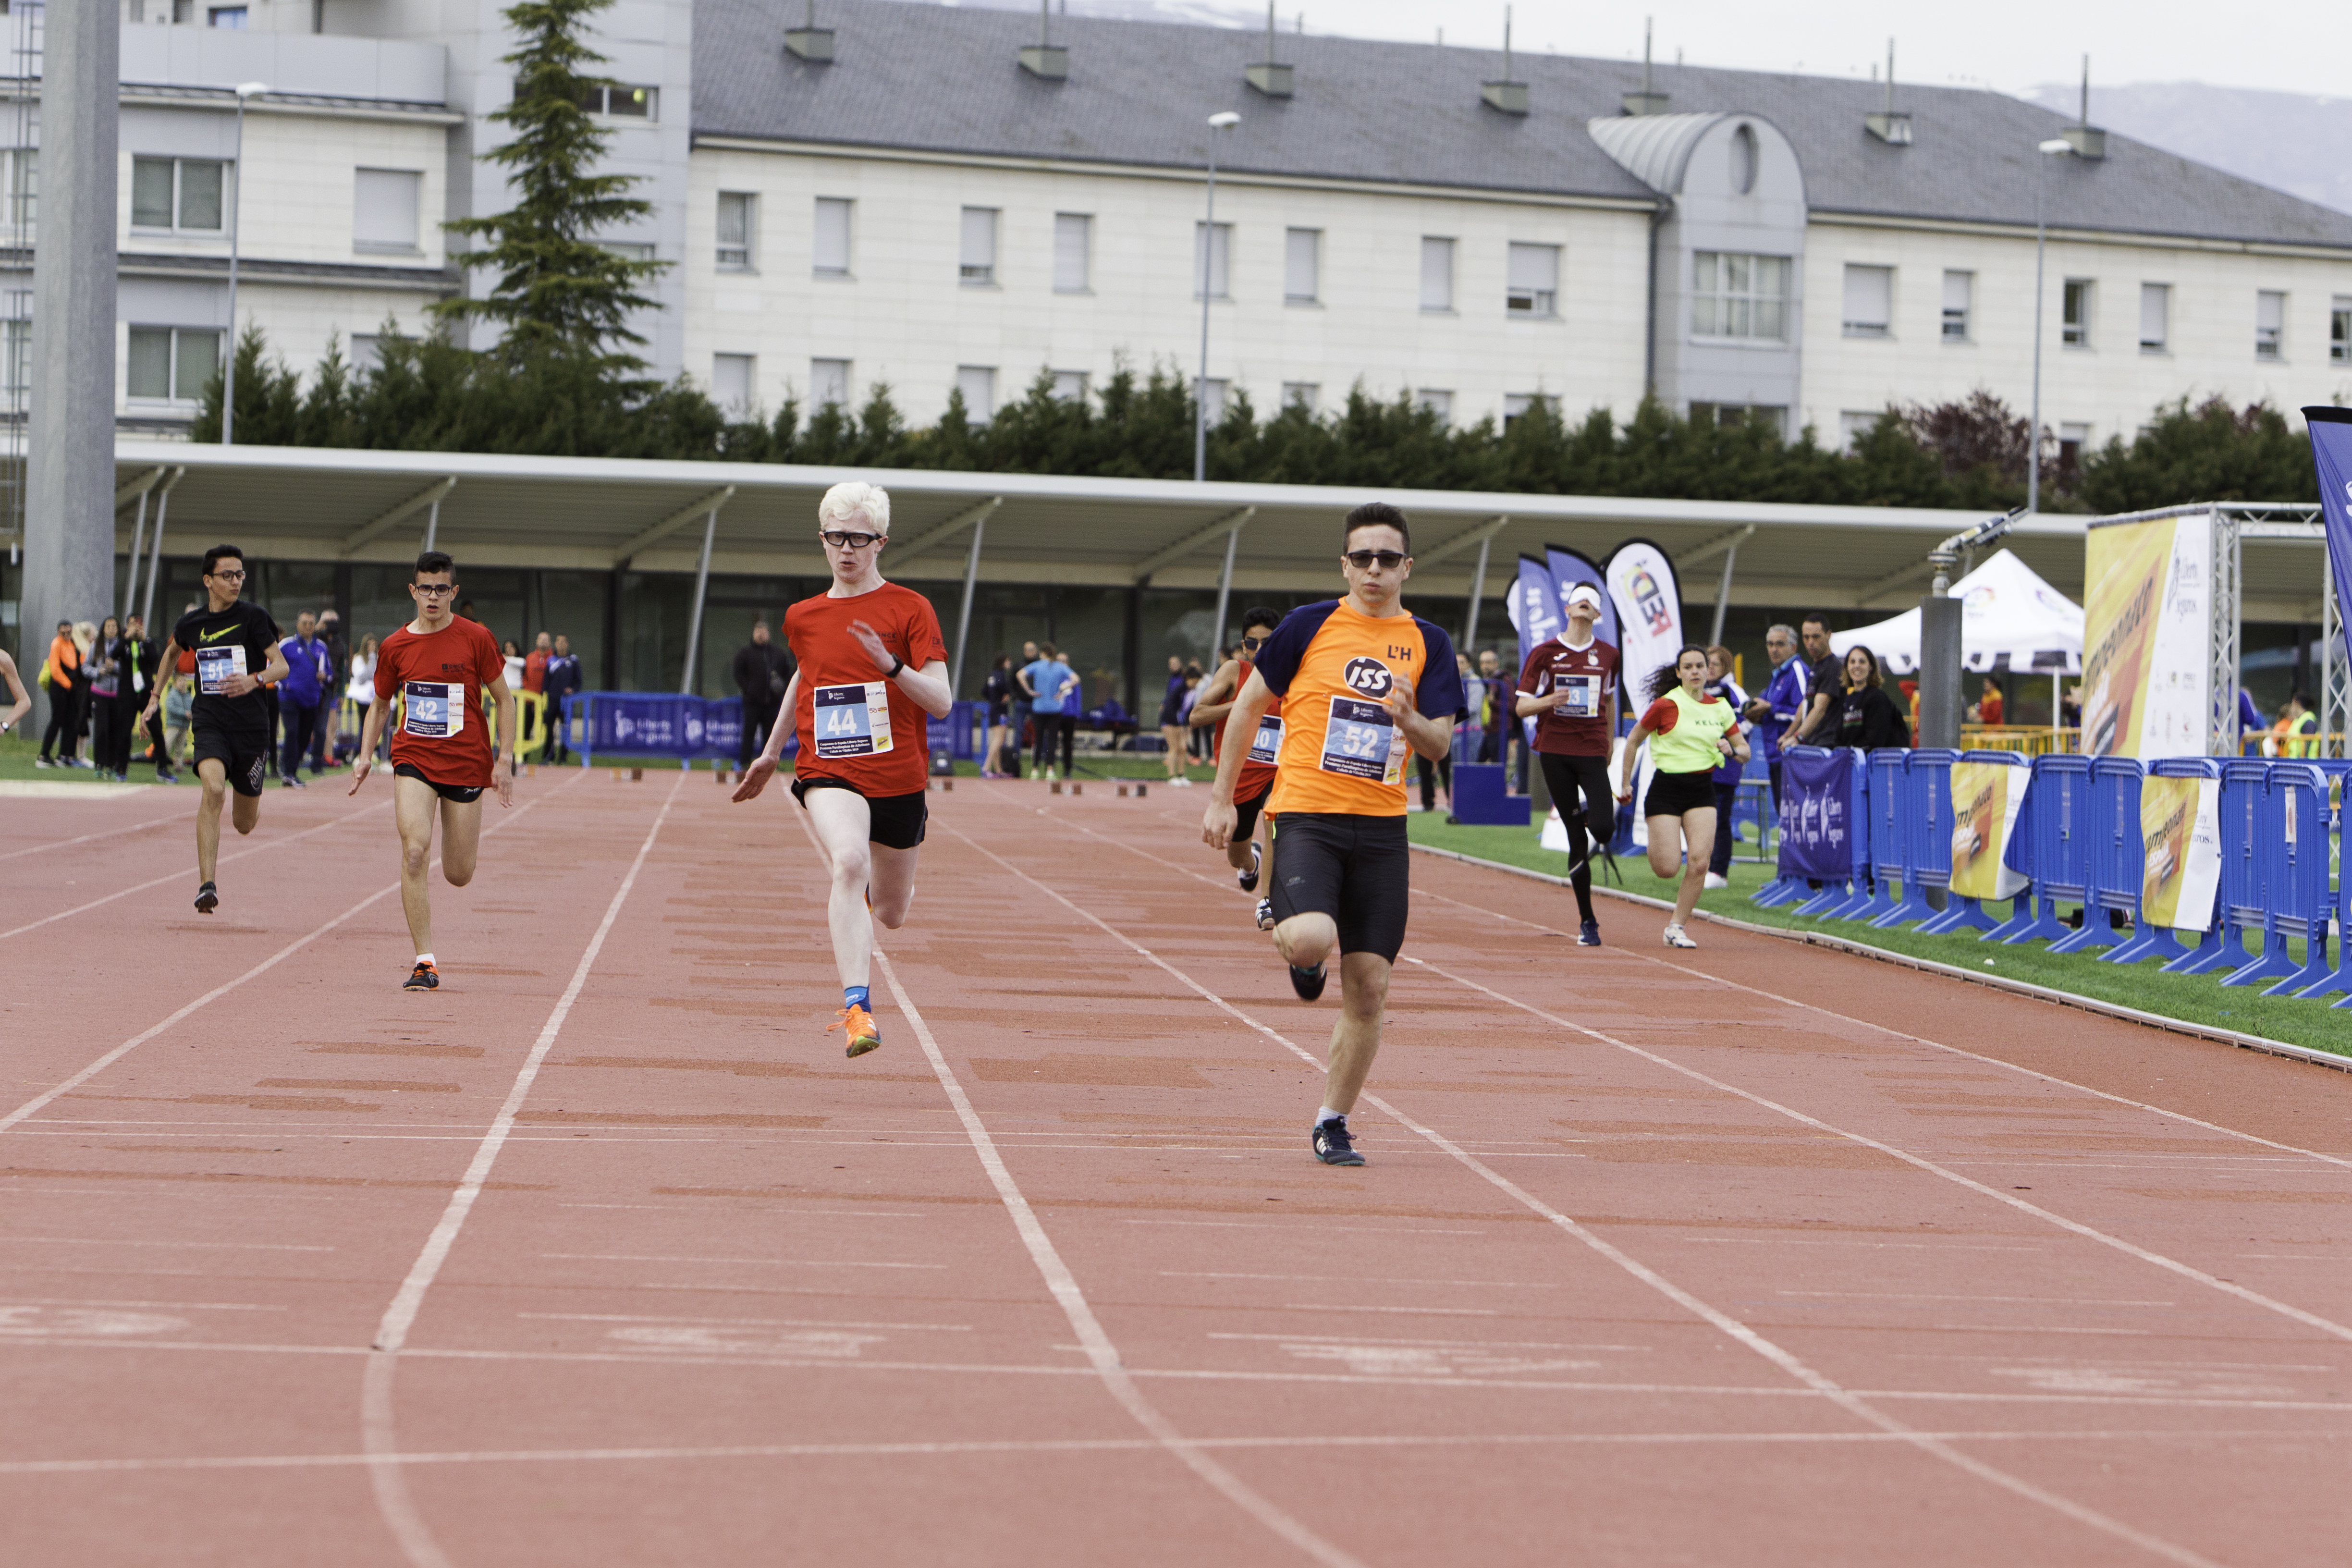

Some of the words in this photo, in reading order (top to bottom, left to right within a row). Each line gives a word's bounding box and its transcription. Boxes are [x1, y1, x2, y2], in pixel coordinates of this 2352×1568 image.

[208, 660, 223, 679] 51
[416, 700, 437, 720] 42
[827, 709, 857, 735] 44
[1343, 725, 1378, 758] 52
